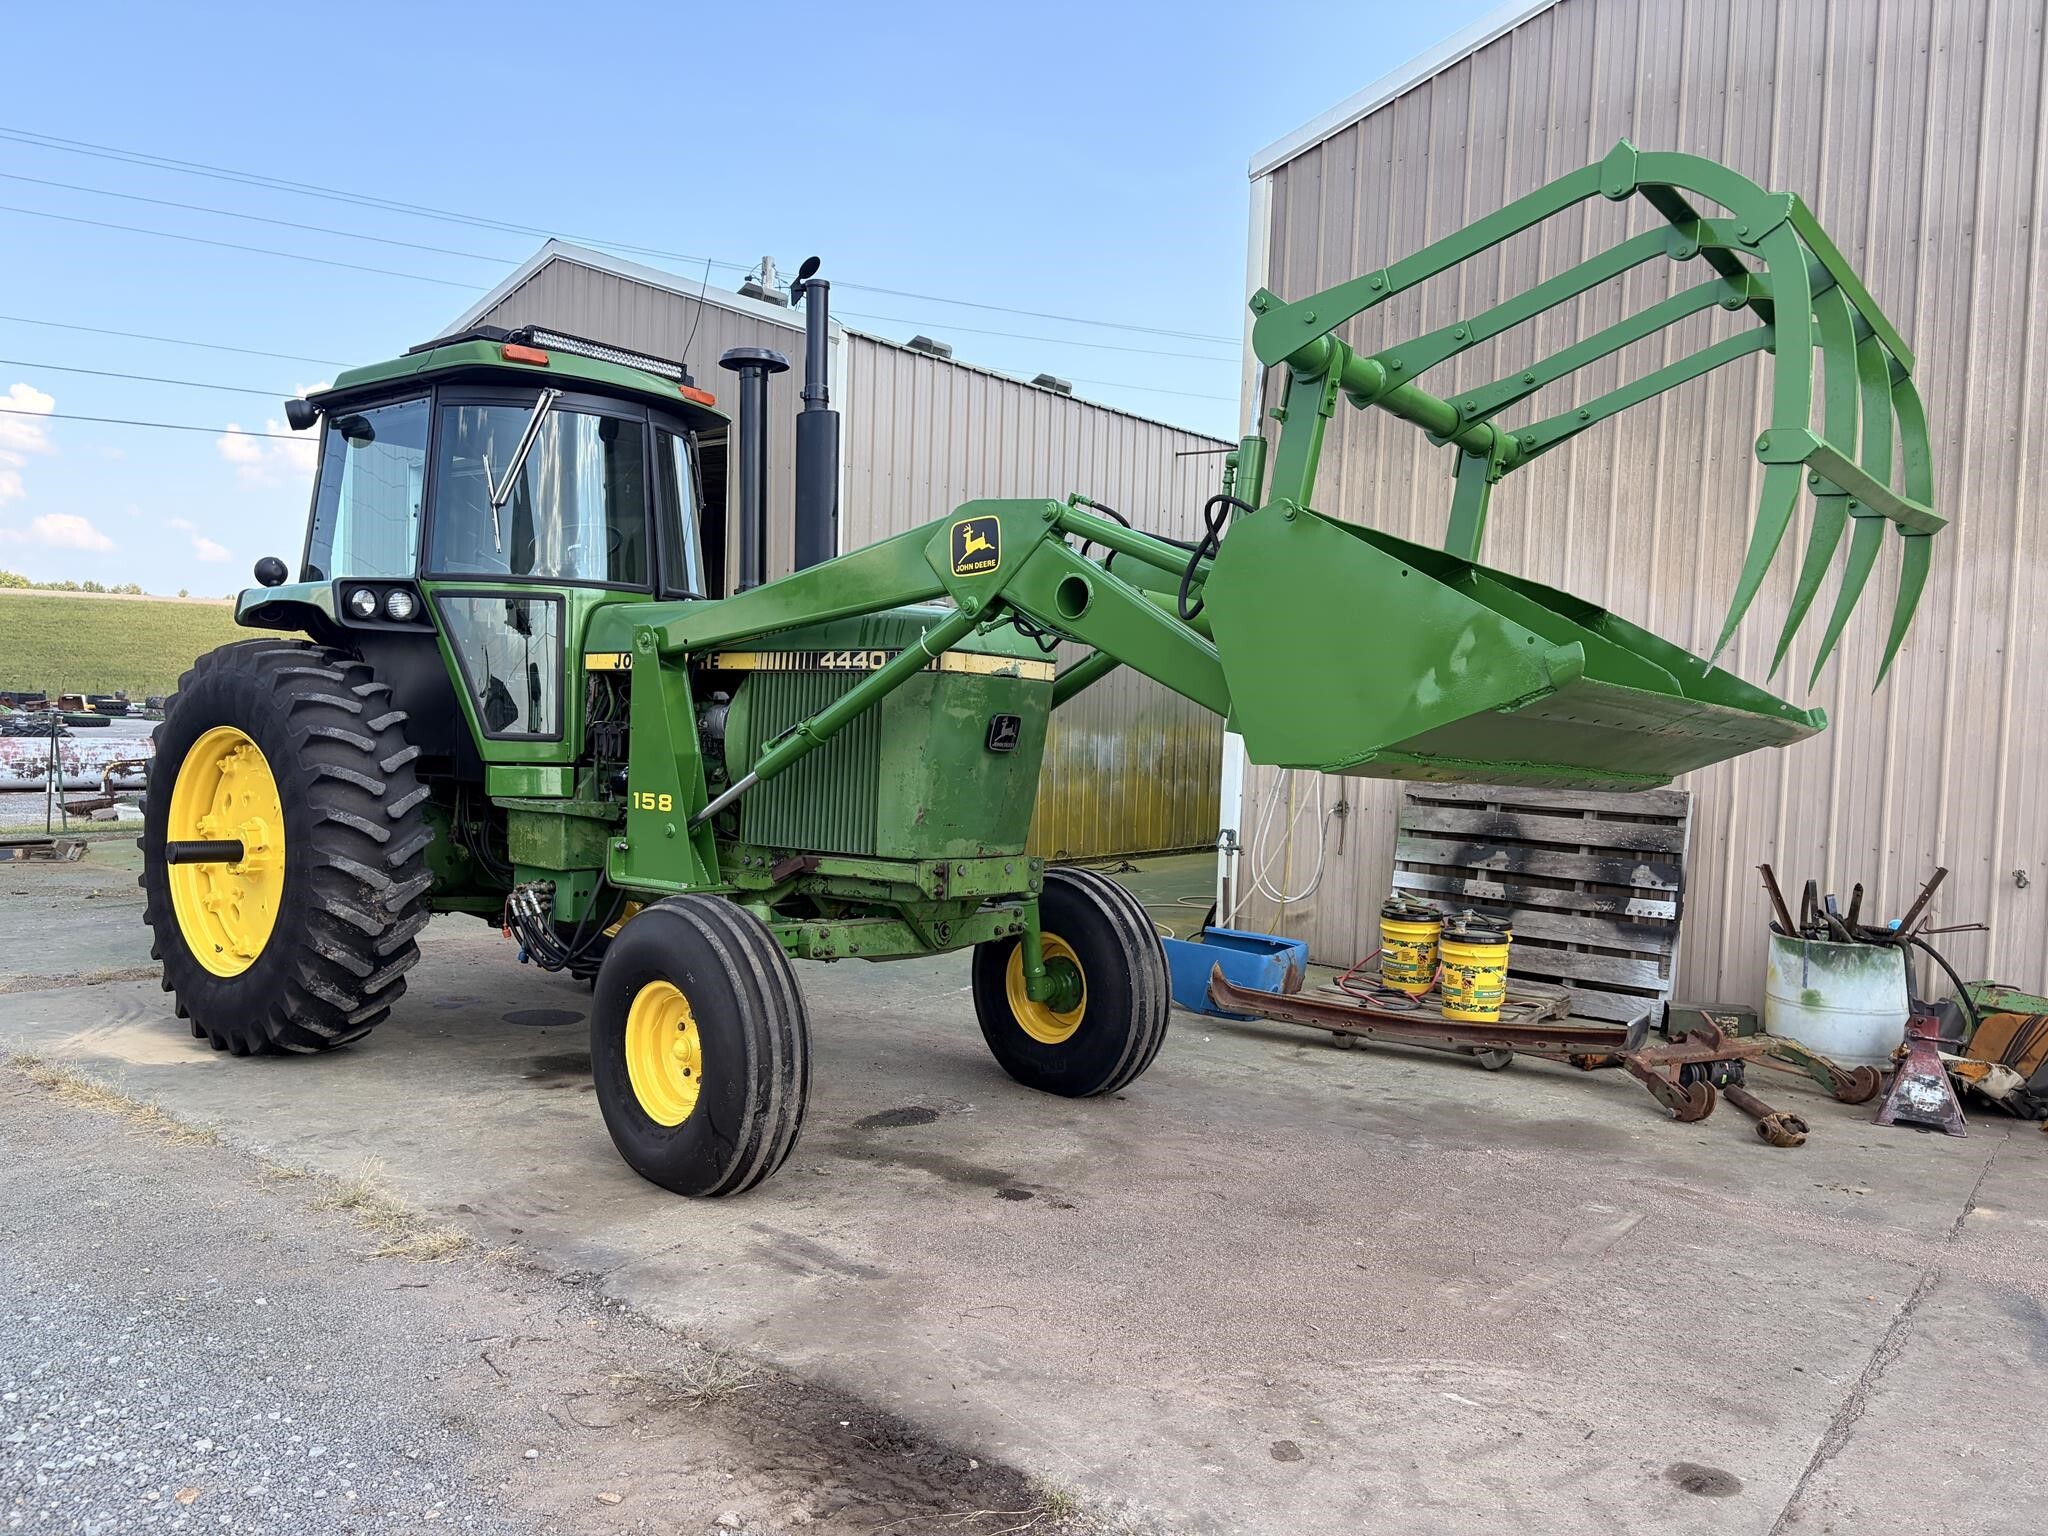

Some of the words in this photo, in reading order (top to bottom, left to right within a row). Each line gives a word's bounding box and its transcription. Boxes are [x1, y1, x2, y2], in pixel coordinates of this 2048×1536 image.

[956, 562, 973, 572] JOHN
[974, 559, 996, 569] DEERE
[614, 653, 633, 669] JO
[820, 651, 887, 670] 4440
[633, 791, 673, 812] 158
